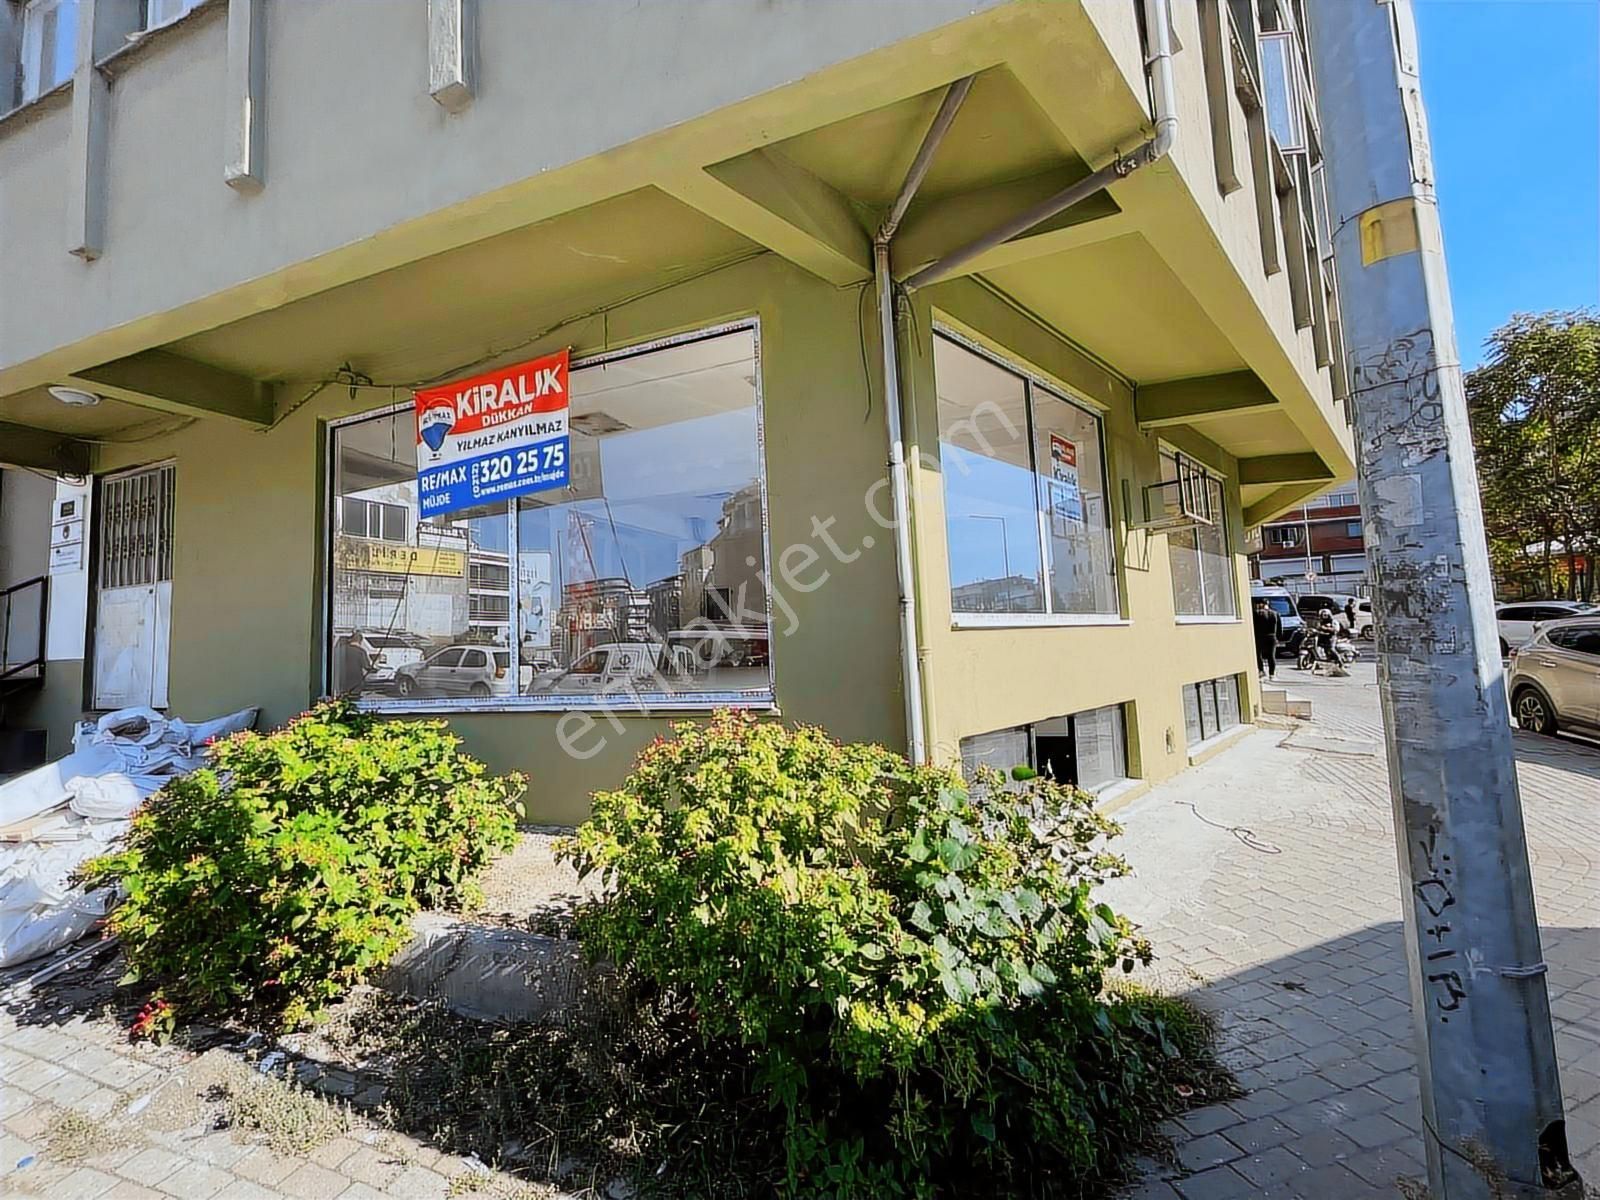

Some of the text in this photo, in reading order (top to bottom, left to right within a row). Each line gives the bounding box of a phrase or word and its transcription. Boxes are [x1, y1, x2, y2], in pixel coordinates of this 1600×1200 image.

[481, 402, 533, 427] DÜKKAN
[456, 420, 562, 452] YILMAZ KANYILMAZ
[480, 455, 512, 483] 320
[516, 449, 538, 475] 25
[543, 443, 564, 469] 75
[421, 465, 467, 493] RE/MAX
[422, 493, 451, 510] MÜJDE
